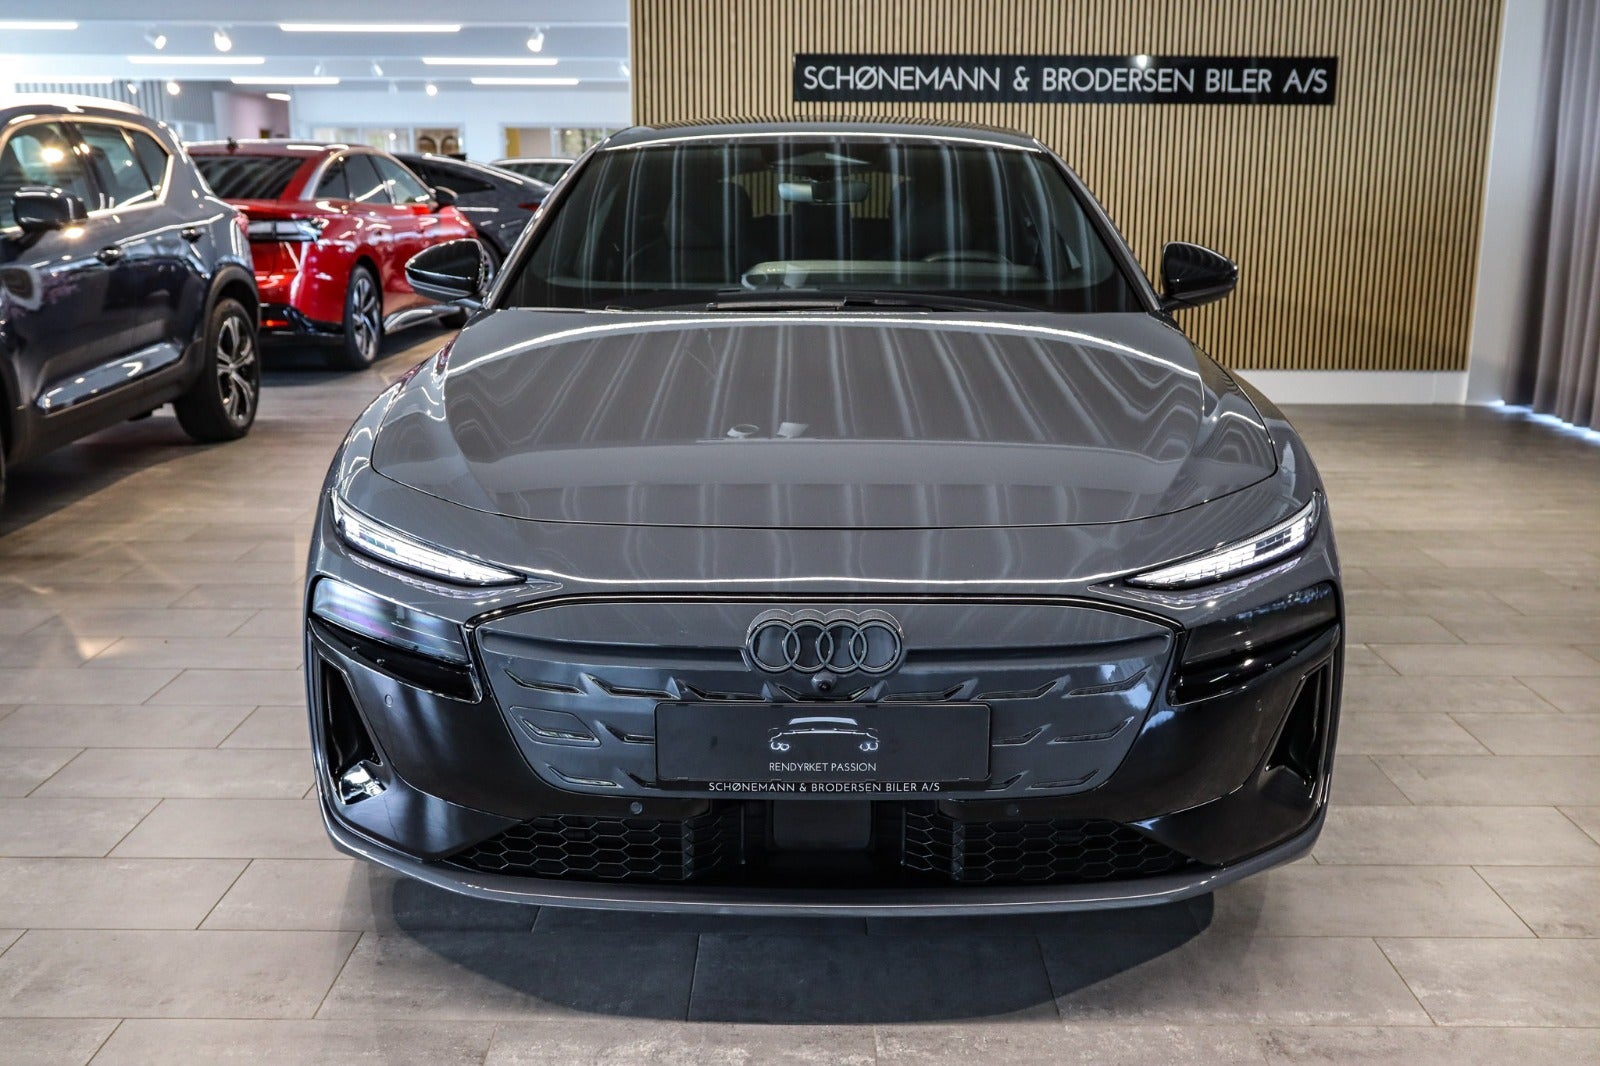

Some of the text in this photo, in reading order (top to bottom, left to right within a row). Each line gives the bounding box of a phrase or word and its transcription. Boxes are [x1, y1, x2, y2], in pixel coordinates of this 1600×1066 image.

[804, 65, 1328, 94] SCHØNEMANN & BRODERSEN BILER A/S
[769, 762, 877, 772] RENDYRKET PASSION
[708, 782, 940, 793] SCHØNEMANN & BRODERSEN BILER A/S
